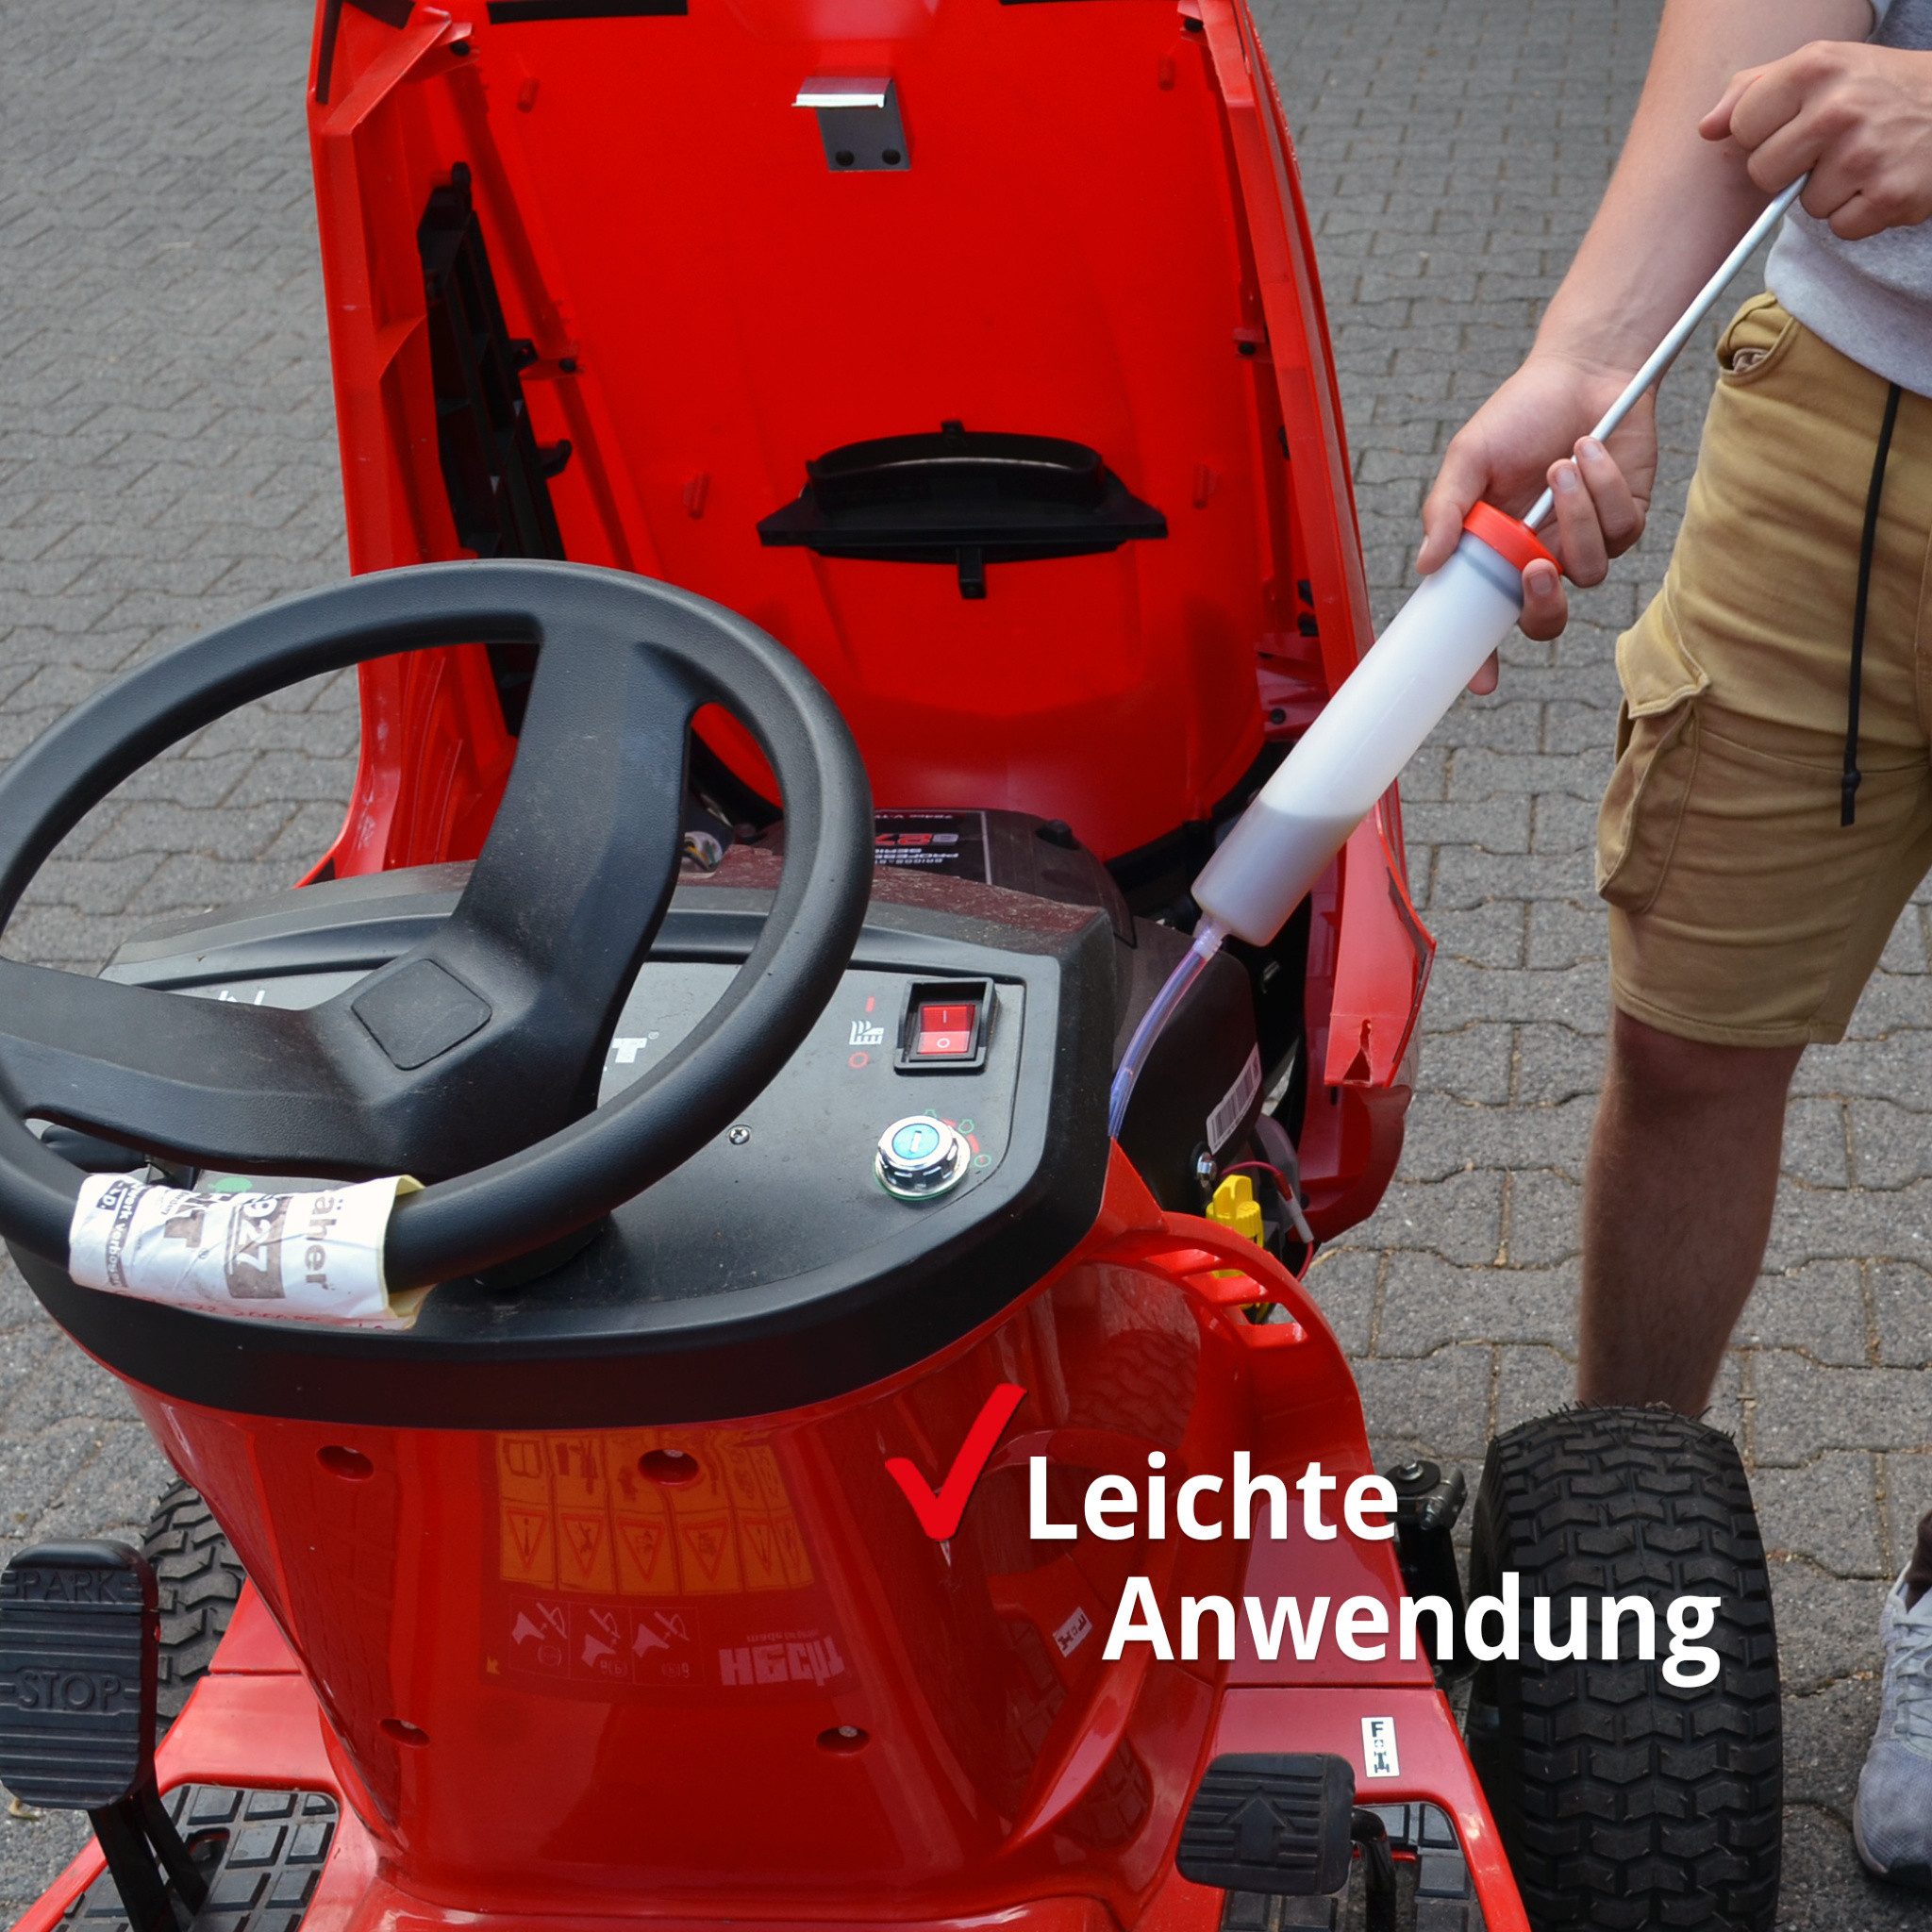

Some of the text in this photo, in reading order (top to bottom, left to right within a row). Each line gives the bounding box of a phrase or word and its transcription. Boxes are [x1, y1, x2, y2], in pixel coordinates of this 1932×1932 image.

[236, 1190, 278, 1272] 927
[23, 1570, 117, 1603] PARK
[19, 1670, 121, 1711] STOP
[1371, 1722, 1383, 1737] F
